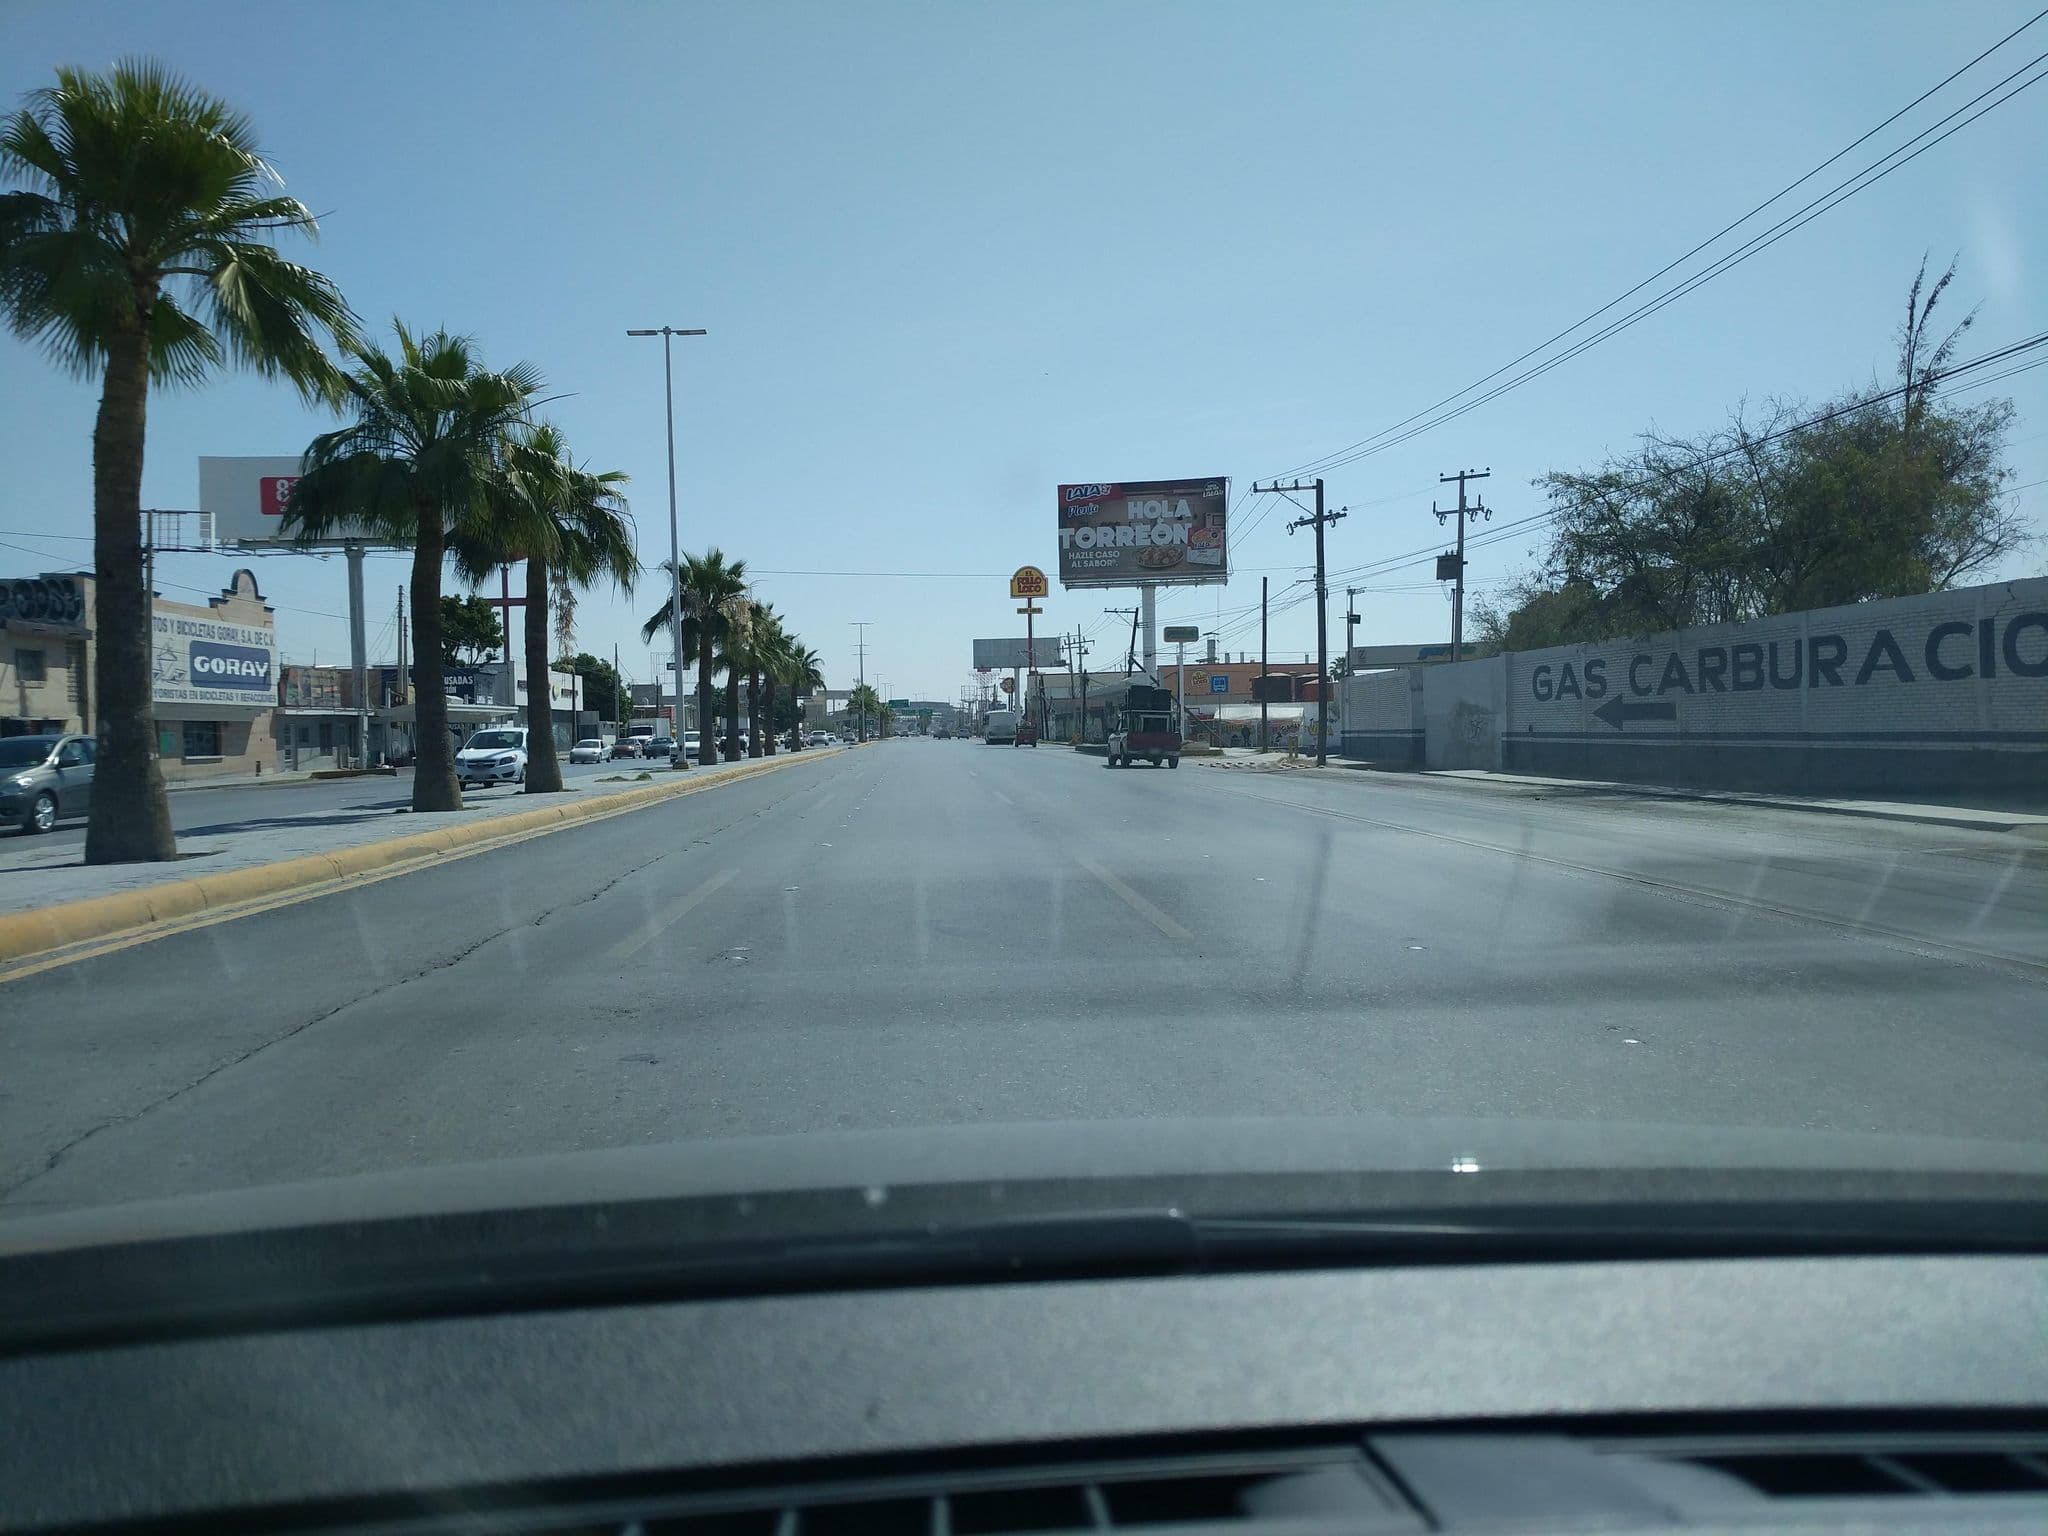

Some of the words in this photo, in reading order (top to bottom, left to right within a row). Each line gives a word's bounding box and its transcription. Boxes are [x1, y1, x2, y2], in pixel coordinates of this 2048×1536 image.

[1066, 485, 1102, 501] LALA
[1127, 499, 1192, 520] HOLA
[1068, 551, 1094, 560] HAZLE
[1095, 550, 1120, 559] CASO
[1071, 560, 1082, 568] AL
[169, 619, 175, 635] Y
[177, 620, 216, 639] BICICLETAS
[254, 631, 263, 645] DE
[1532, 660, 1608, 701] GAS
[1628, 612, 2048, 697] CARBURACIO
[193, 655, 269, 677] GORAY
[444, 676, 474, 685] USADAS
[189, 689, 198, 700] EN
[200, 690, 234, 701] BICICLETAS
